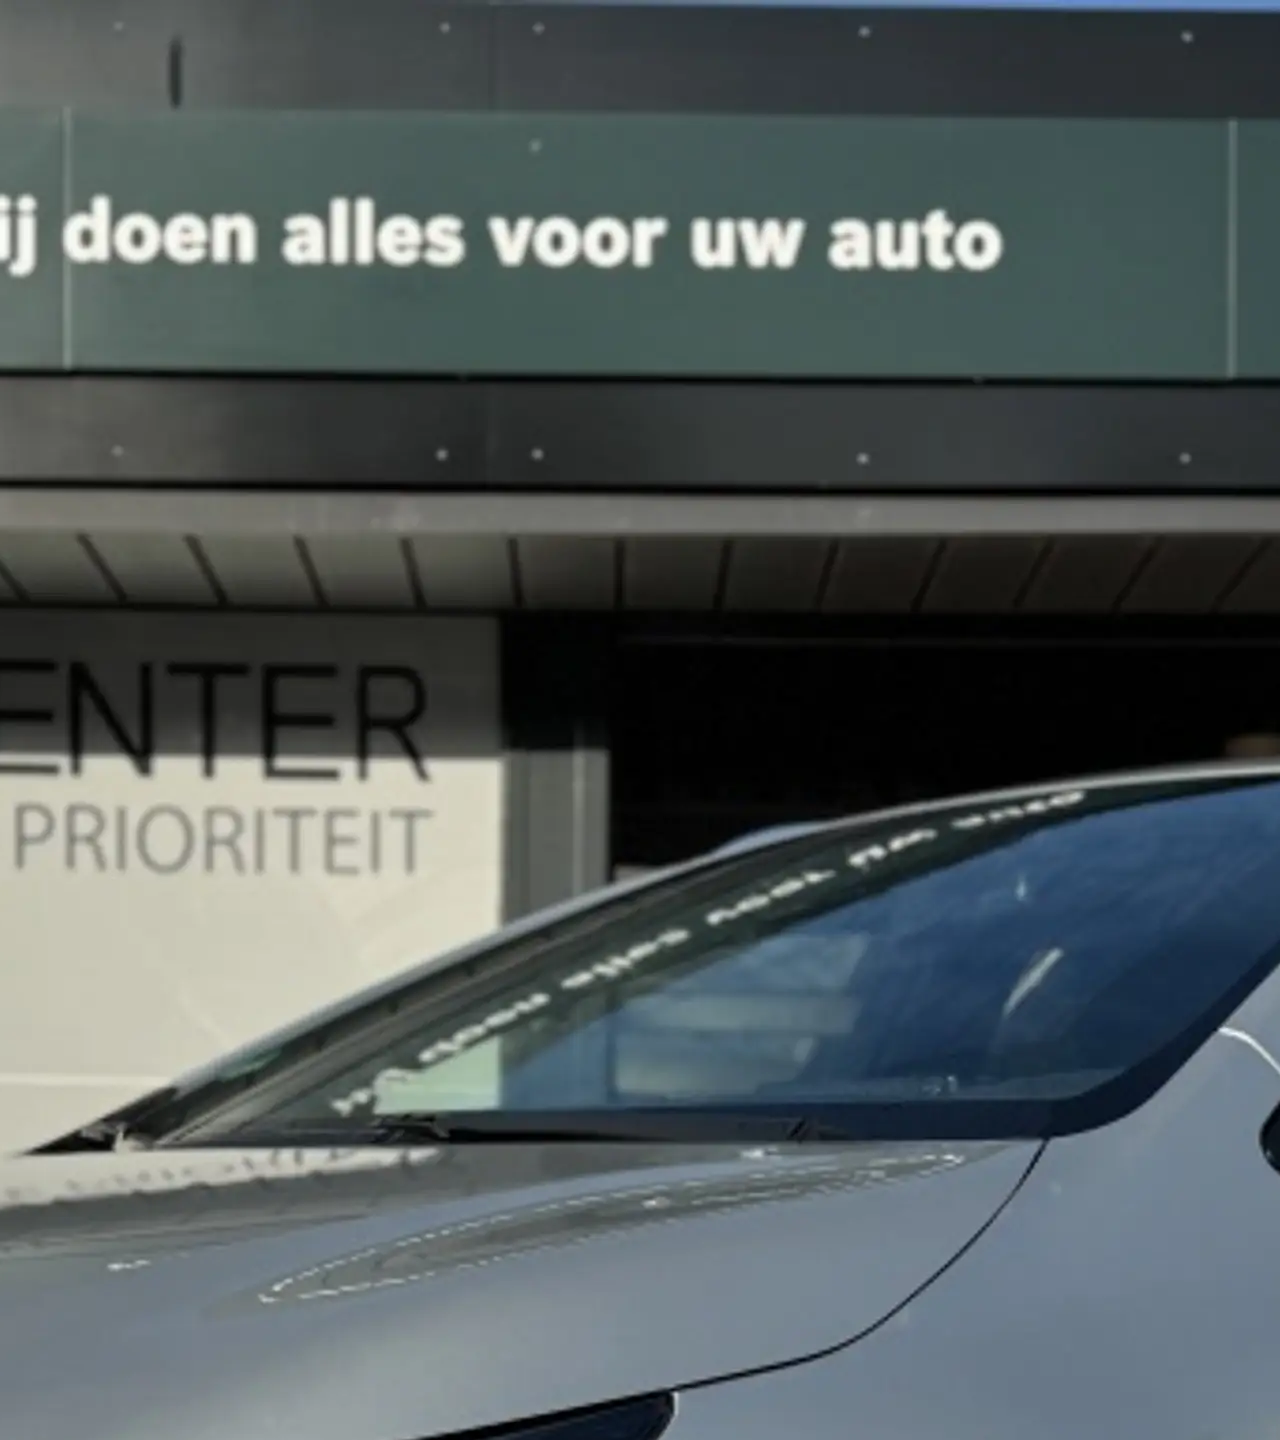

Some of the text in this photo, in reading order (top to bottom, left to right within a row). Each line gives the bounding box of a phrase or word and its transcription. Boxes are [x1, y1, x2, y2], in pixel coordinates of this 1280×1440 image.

[63, 196, 255, 263] doen
[283, 198, 464, 265] alles
[490, 218, 666, 266] voor
[693, 220, 803, 267] uw
[830, 211, 1001, 270] auto
[15, 803, 435, 875] PRIORITEIT
